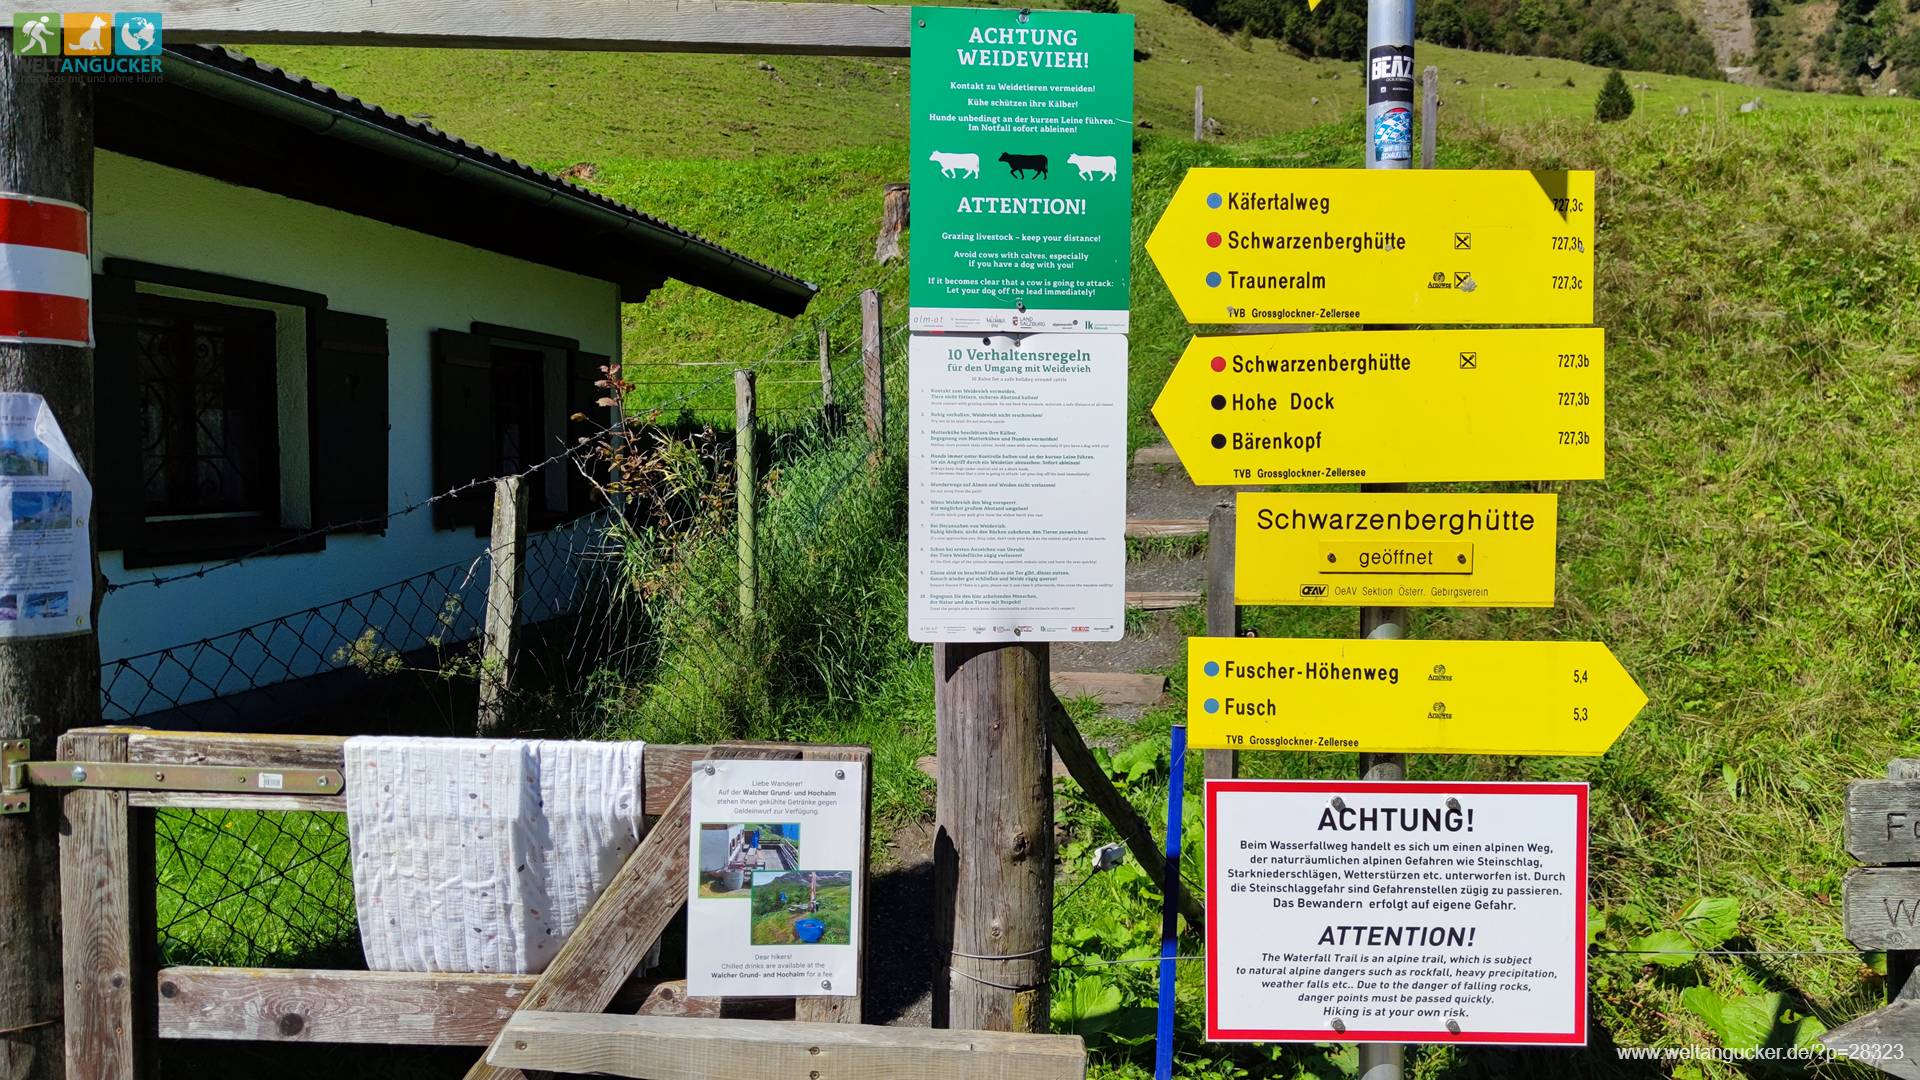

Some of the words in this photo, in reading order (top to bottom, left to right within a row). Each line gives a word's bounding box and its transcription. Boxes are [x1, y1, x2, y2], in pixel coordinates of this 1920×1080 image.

[968, 27, 1078, 45] ACHTUNG
[957, 49, 1089, 67] WEIDEVIEH!
[1372, 55, 1414, 81] BEAZ
[950, 82, 984, 90] Kontakt
[998, 83, 1048, 91] Weidetieren
[958, 115, 1001, 123] unbedingt
[1040, 125, 1077, 133] ableinen!
[957, 197, 1086, 214] ATTENTION!
[1229, 193, 1330, 214] Käfertalweg
[1553, 198, 1584, 213] 727,3c
[942, 232, 975, 241] Grazing
[1022, 234, 1041, 242] keep
[1064, 234, 1101, 242] distance!
[1228, 231, 1406, 253] Schwarzenberghütte
[1049, 253, 1089, 261] especially
[1228, 272, 1325, 289] Trauneralm
[1552, 276, 1583, 290] 727,3c
[1252, 308, 1360, 320] Grossglockner-Zellersee
[948, 350, 962, 360] 10
[966, 349, 1091, 364] Verhaltensregeln
[1558, 354, 1590, 368] 727,3b
[984, 365, 1023, 374] Umgang
[1042, 363, 1091, 372] Weidevieh
[1233, 354, 1411, 375] Schwarzenberghütte
[1233, 393, 1277, 411] Hohe
[1291, 392, 1334, 410] Dock
[1558, 392, 1590, 406] 727,3b
[1233, 432, 1322, 453] Bärenkopf
[1558, 432, 1590, 446] 727,3b
[1233, 469, 1251, 478] TVB
[1257, 468, 1366, 479] Grossglockner-Zellersee
[1257, 509, 1534, 535] Schwarzenberghütte
[1359, 549, 1433, 568] geöffnet
[1335, 586, 1357, 595] OeAV
[1362, 587, 1393, 596] Sektion
[1431, 587, 1489, 598] Gebirgsverein
[1226, 662, 1399, 684] Fuscher-Höhenweg
[1574, 670, 1588, 684] 5,4
[1225, 698, 1276, 716] Fusch
[1574, 708, 1588, 722] 5,3
[1226, 735, 1244, 744] TVB
[1249, 736, 1359, 748] Grossglockner-Zellersee
[1317, 807, 1474, 832] ACHTUNG!
[1240, 841, 1267, 849] Beim
[1270, 841, 1348, 852] Wasserfallweg
[1351, 842, 1391, 850] handelt
[1409, 842, 1430, 851] sich
[1453, 843, 1482, 851] einen
[1485, 843, 1524, 854] alpinen
[1527, 844, 1553, 854] Weg,
[1250, 855, 1268, 864] der
[1271, 856, 1360, 864] naturräumlichen
[1363, 856, 1402, 867] alpinen
[1405, 857, 1453, 865] Gefahren
[1456, 857, 1475, 865] wie
[1478, 857, 1543, 868] Steinschlag,
[1228, 869, 1341, 881] Starkniederschlägen,
[1344, 870, 1420, 879] Wetterstürzen
[1423, 872, 1442, 880] etc.
[1445, 872, 1512, 880] unterworfen
[1515, 872, 1531, 880] ist.
[1534, 872, 1566, 881] Durch
[1231, 884, 1247, 892] die
[1249, 884, 1345, 895] Steinschlaggefahr
[1348, 885, 1370, 893] sind
[1373, 885, 1458, 894] Gefahrenstellen
[1461, 886, 1489, 897] zügig
[1507, 887, 1562, 897] passieren.
[1273, 898, 1294, 907] Das
[1298, 899, 1363, 908] Bewandern
[1369, 899, 1408, 911] erfolgt
[1411, 900, 1430, 909] auf
[1433, 900, 1471, 912] eigene
[1475, 900, 1516, 910] Gefahr.
[1318, 926, 1476, 946] ATTENTION!
[1262, 953, 1281, 961] The
[1283, 954, 1331, 962] Waterfall
[1334, 954, 1358, 962] Trail
[1360, 954, 1369, 962] is
[1387, 955, 1419, 964] alpine
[1422, 955, 1447, 964] trail,
[1450, 955, 1480, 963] which
[1494, 956, 1532, 966] subject
